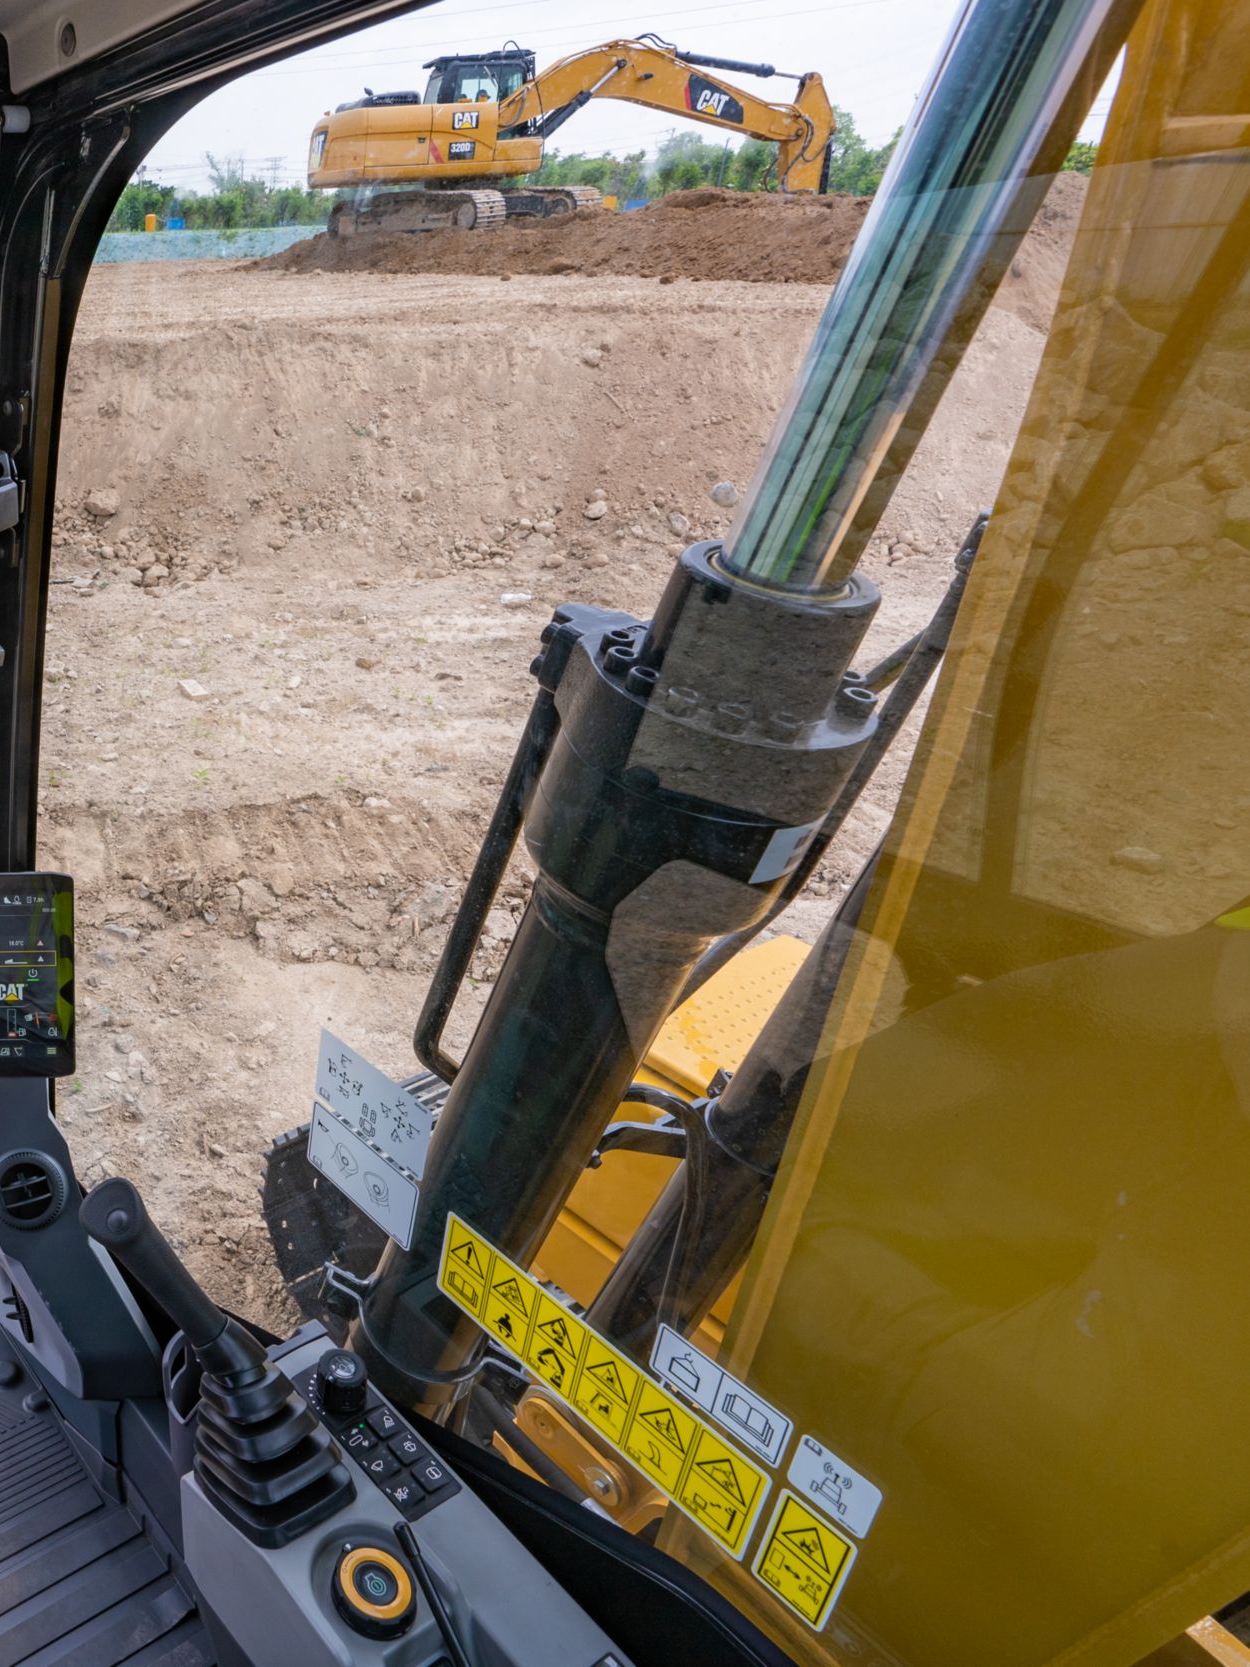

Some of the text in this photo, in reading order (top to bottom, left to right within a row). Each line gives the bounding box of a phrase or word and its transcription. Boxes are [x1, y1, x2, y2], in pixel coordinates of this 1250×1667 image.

[696, 89, 730, 116] CAT
[454, 112, 479, 129] CAT
[450, 143, 471, 153] 320D
